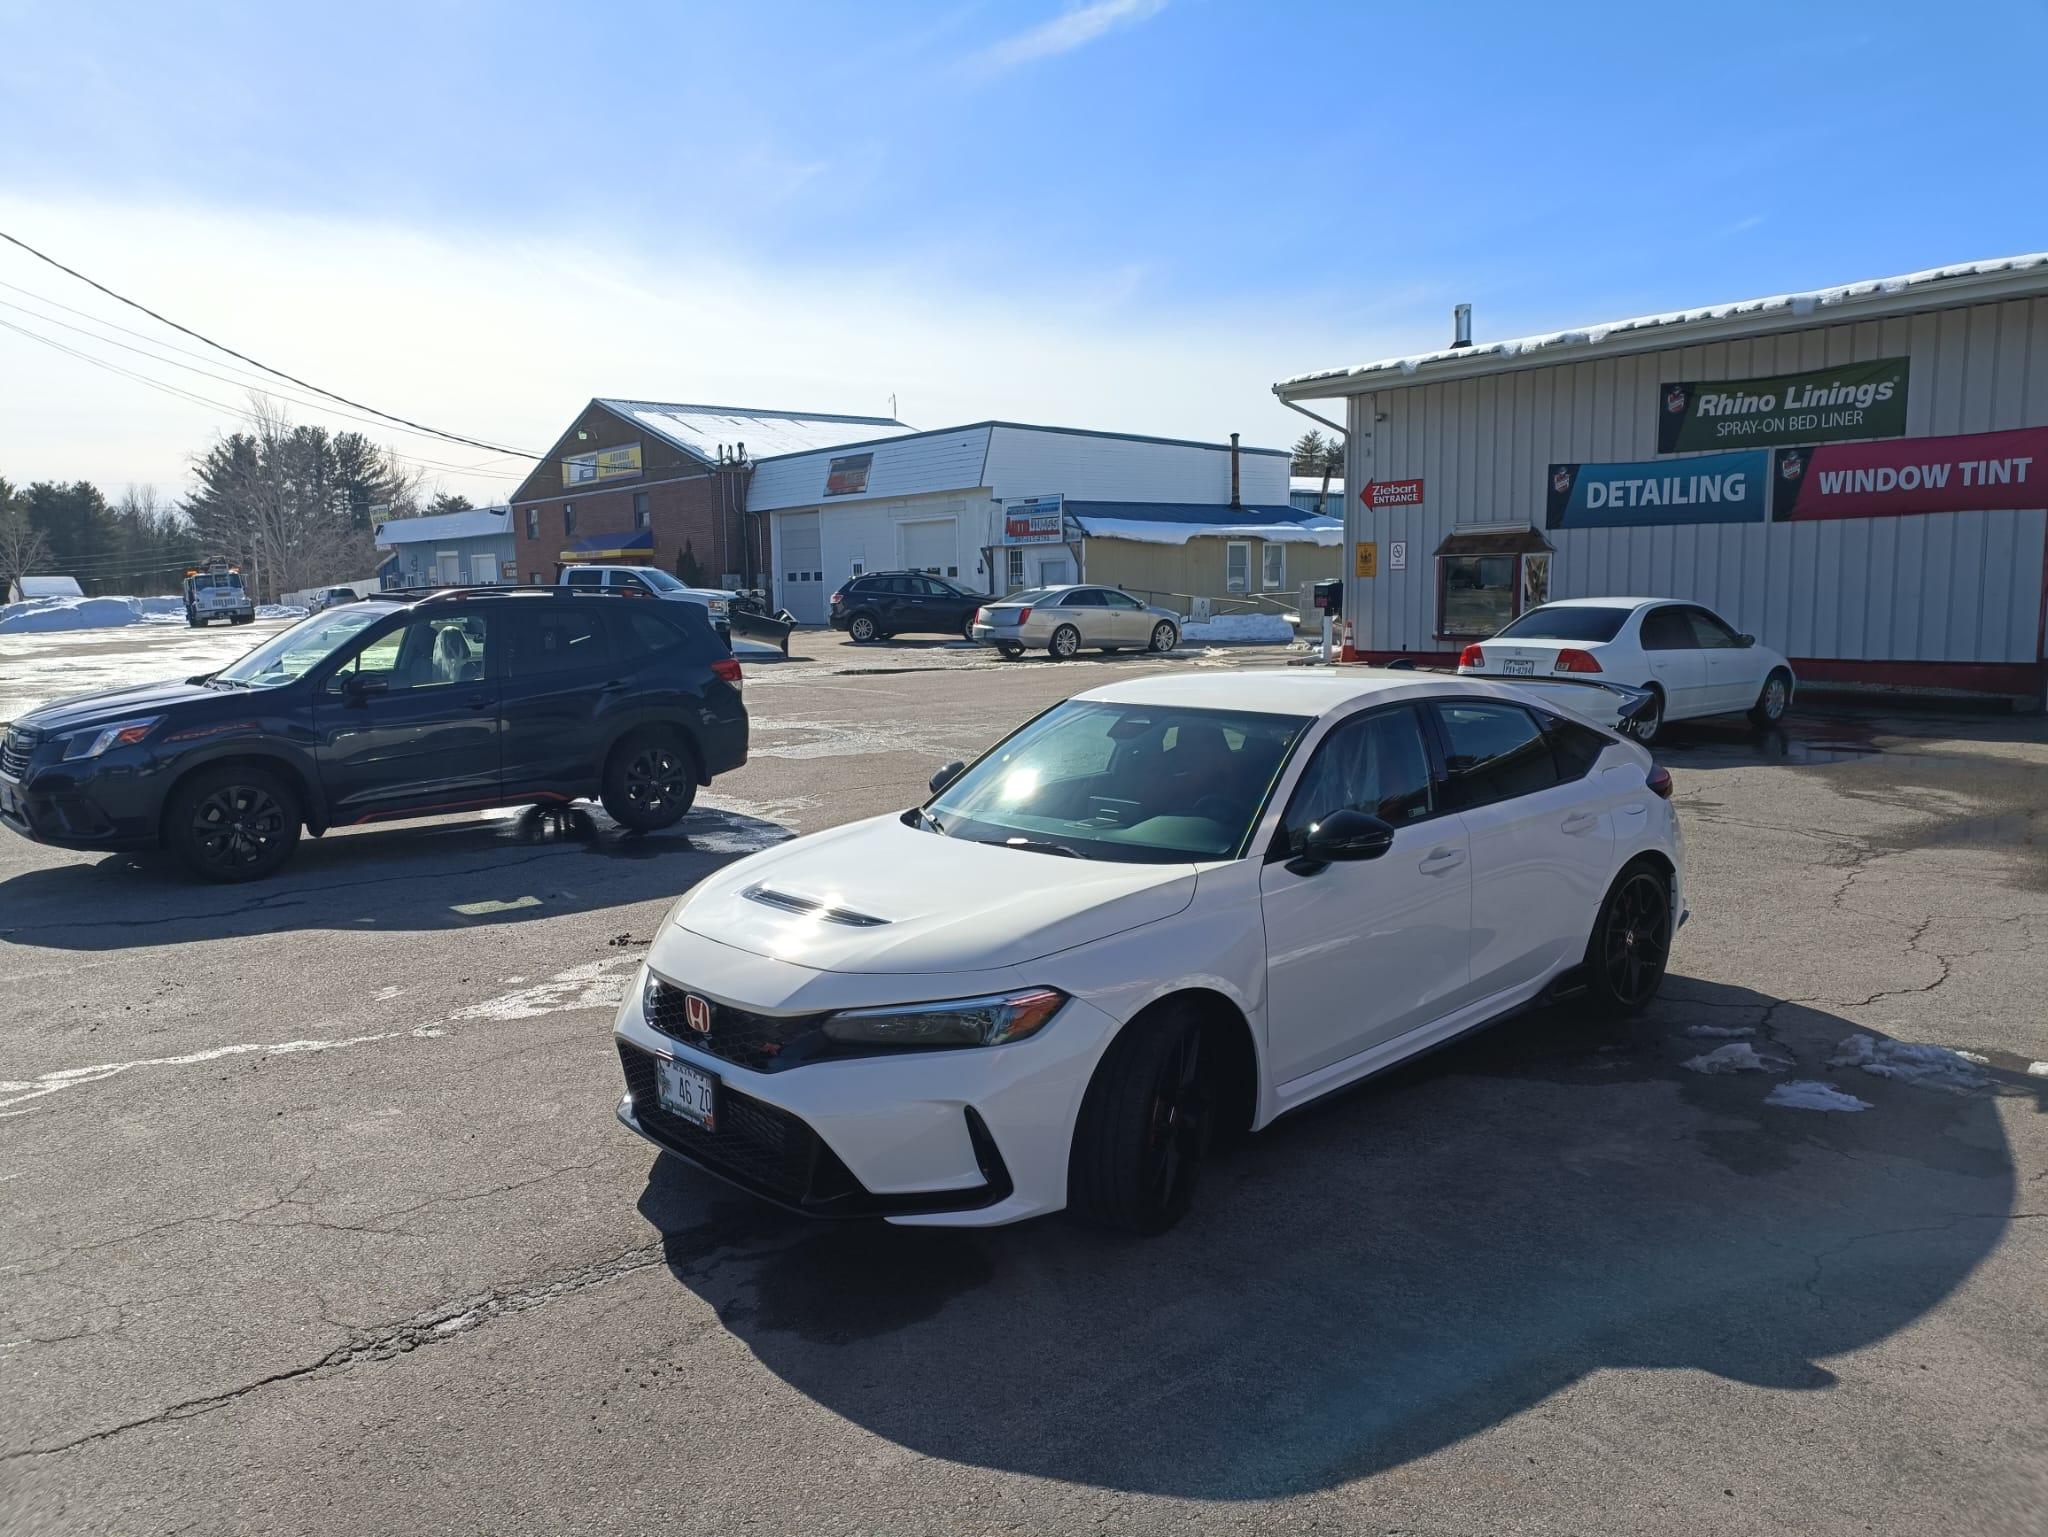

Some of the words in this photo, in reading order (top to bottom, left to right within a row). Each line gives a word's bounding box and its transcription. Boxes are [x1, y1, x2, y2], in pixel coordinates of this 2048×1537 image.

[1696, 391, 1776, 418] Rhino
[1784, 380, 1895, 409] Linings
[1716, 417, 1785, 437] SPRAY-ON
[1789, 413, 1818, 431] BED
[1822, 410, 1864, 428] LINER
[1586, 473, 1746, 509] DETAILING
[1819, 463, 1951, 495] WINDOW
[1958, 457, 2033, 487] TINT
[1373, 493, 1418, 503] ENTRANCE
